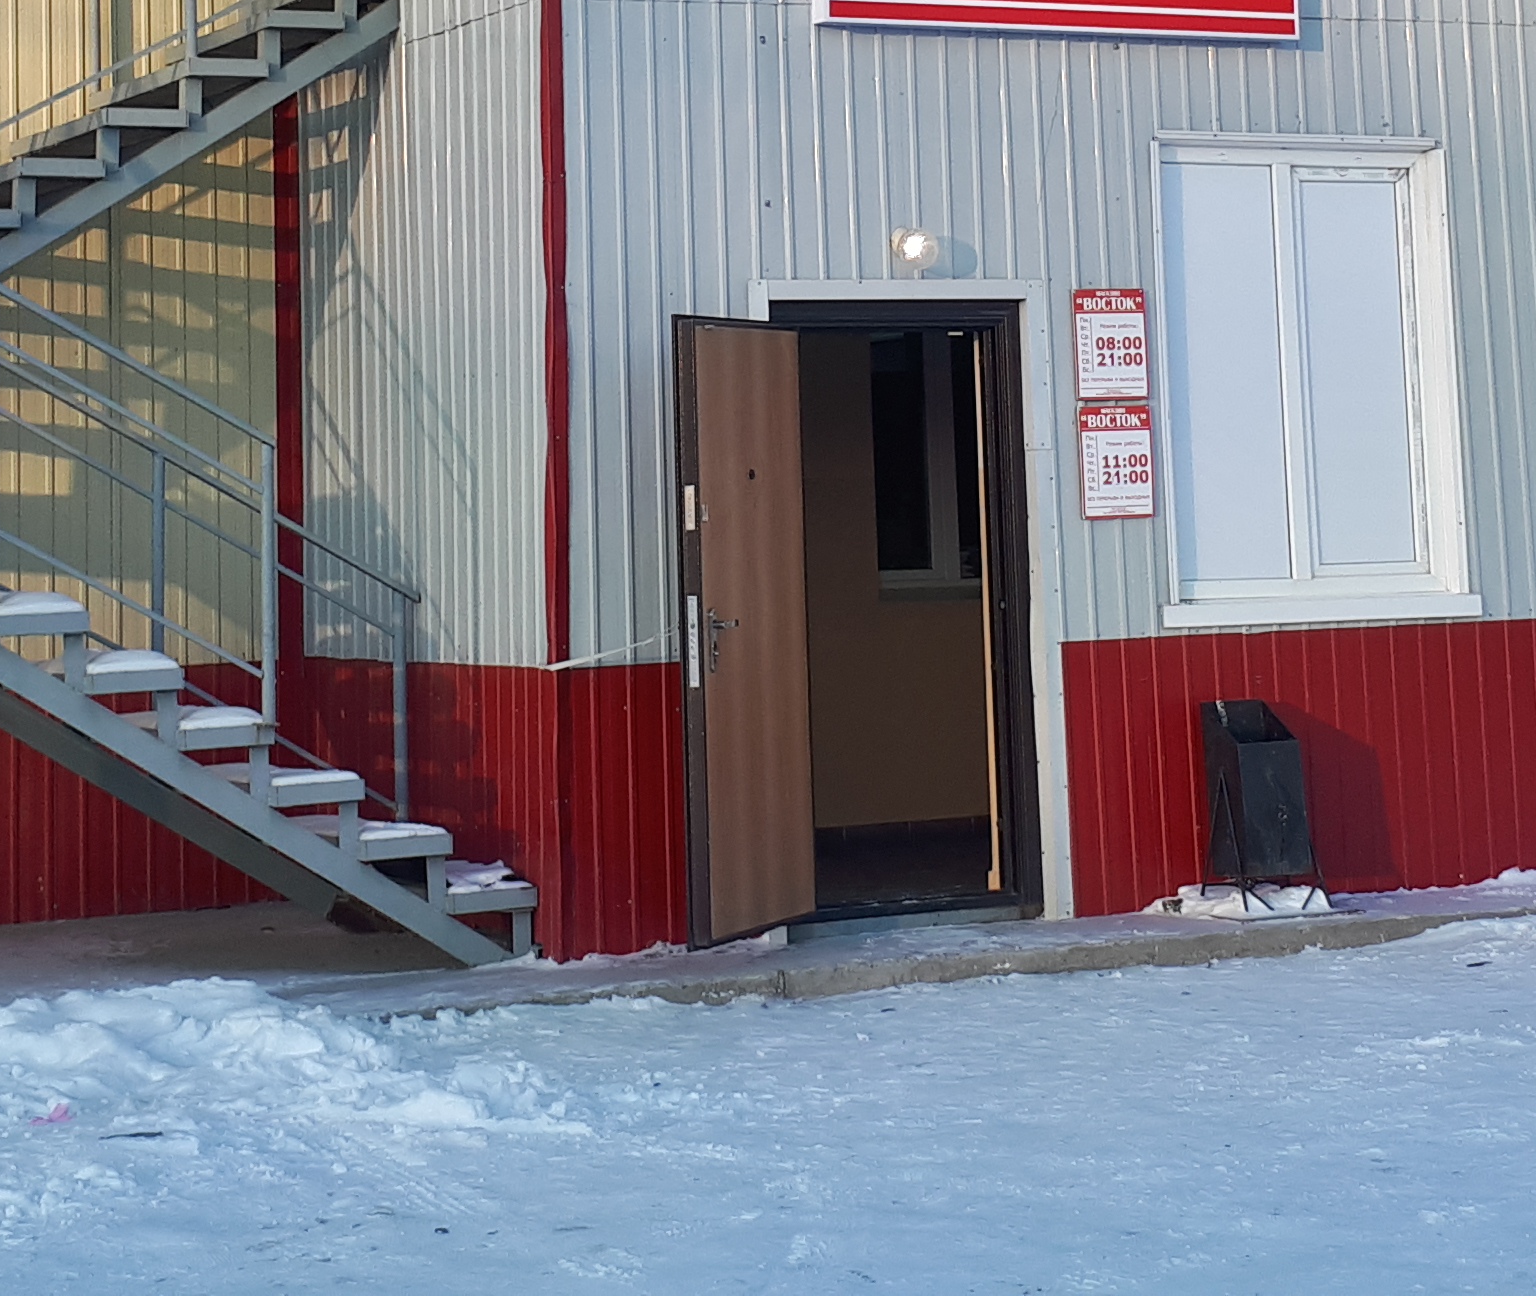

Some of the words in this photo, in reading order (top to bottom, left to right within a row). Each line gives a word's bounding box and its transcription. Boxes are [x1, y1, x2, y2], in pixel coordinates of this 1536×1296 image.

[1096, 337, 1142, 350] 08:00
[1097, 352, 1143, 366] 21:00
[1102, 454, 1148, 468] 11:00
[1103, 470, 1149, 485] 21:00
